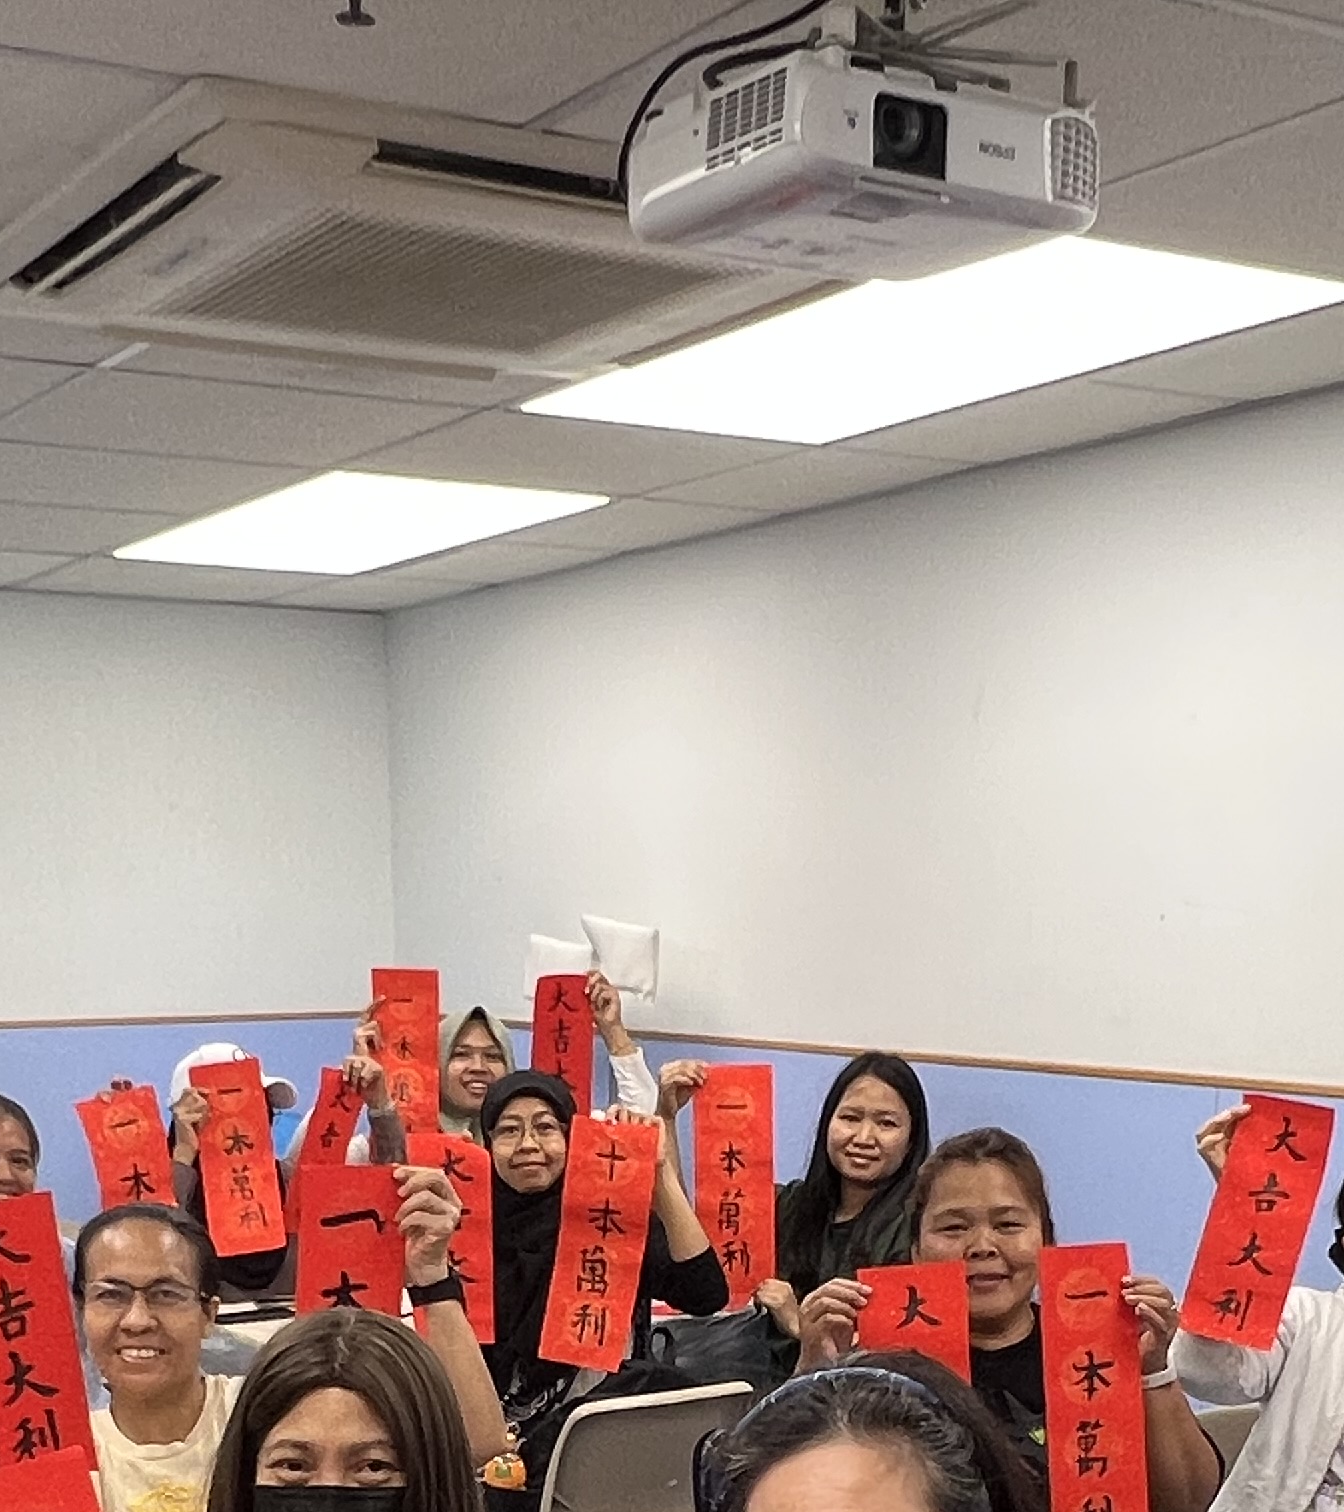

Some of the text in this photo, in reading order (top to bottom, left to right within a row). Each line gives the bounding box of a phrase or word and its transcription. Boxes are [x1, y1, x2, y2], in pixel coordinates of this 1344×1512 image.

[570, 1143, 626, 1346] 十本萬利
[716, 1103, 752, 1278] 一本萬利
[1212, 1116, 1309, 1332] 大吉大利
[895, 1286, 942, 1328] 大
